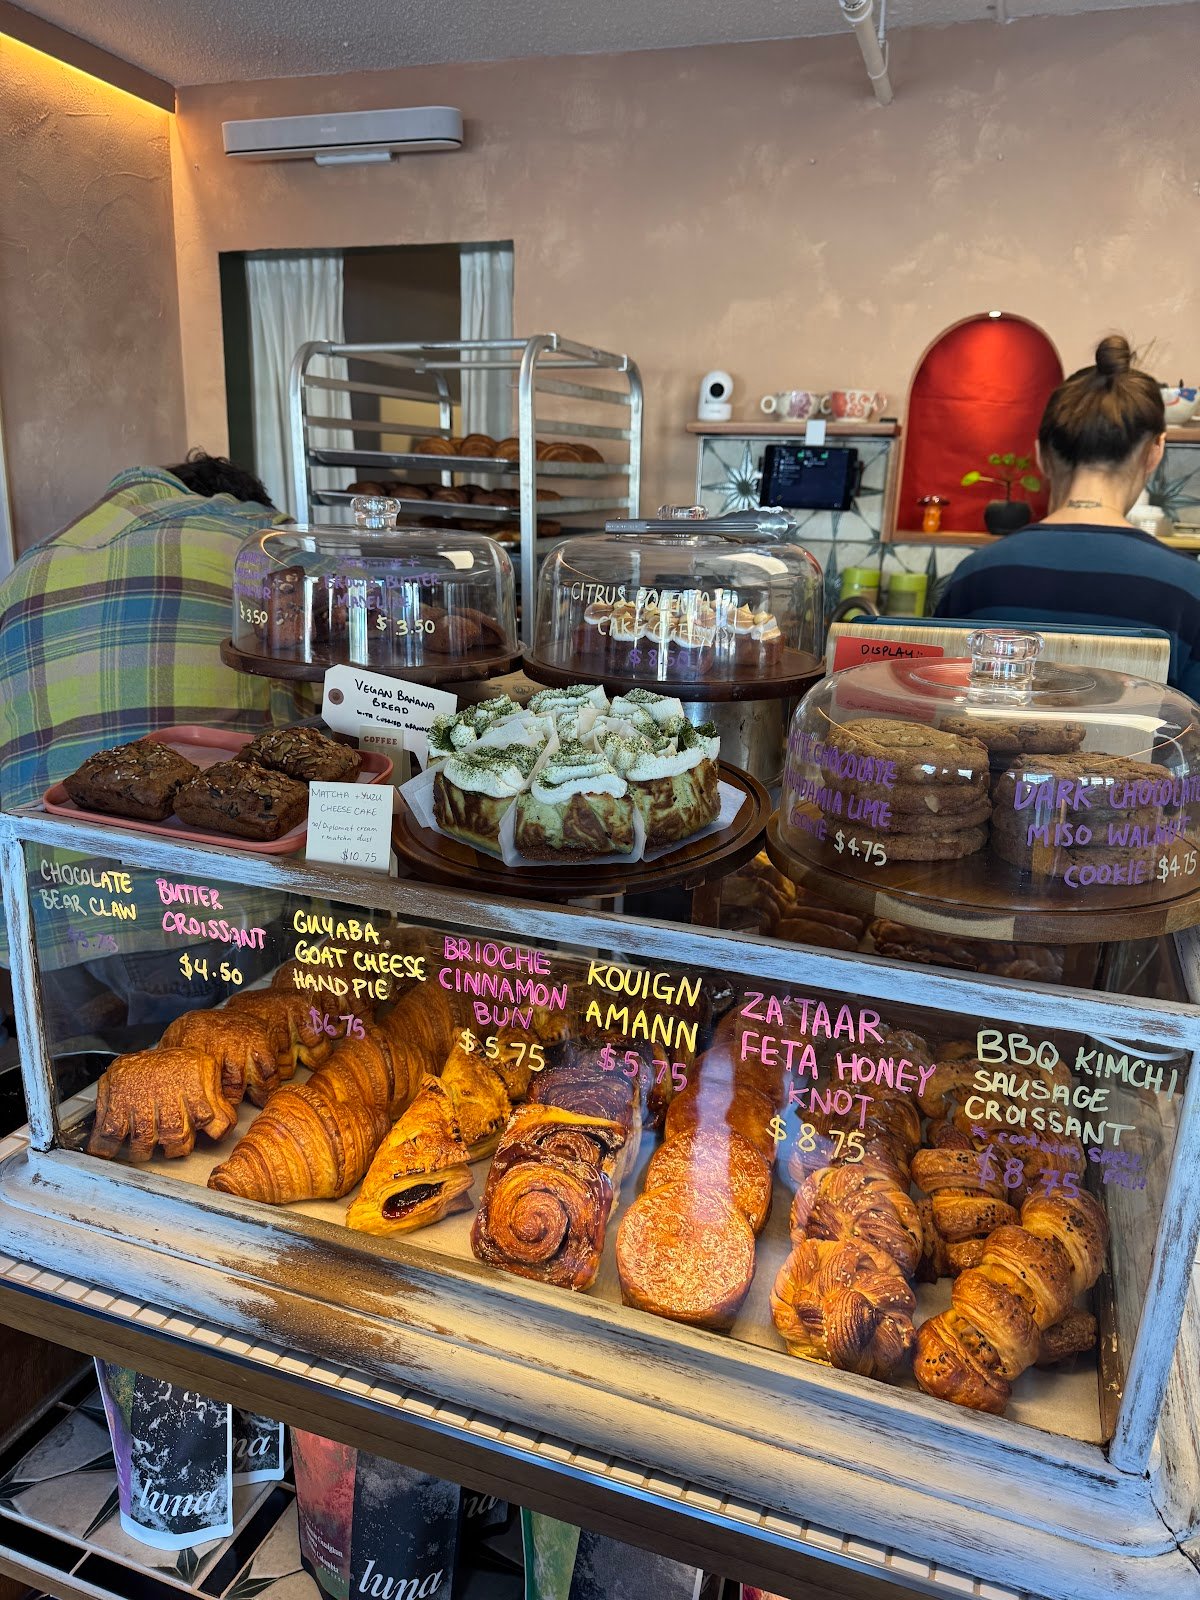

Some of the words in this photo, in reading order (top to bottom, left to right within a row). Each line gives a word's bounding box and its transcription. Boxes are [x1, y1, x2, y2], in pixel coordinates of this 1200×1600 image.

[385, 572, 442, 588] BUTTER
[571, 581, 626, 605] CITRUS
[597, 615, 643, 636] CAKE
[354, 678, 393, 698] VEGAN
[397, 689, 435, 711] BANANA
[372, 697, 409, 715] BREAD
[363, 735, 398, 746] COFFEE
[813, 743, 898, 791] CHOCOLATE
[311, 788, 350, 799] MATCHA
[361, 791, 383, 802] YUZU
[320, 803, 352, 814] CHEESE
[353, 807, 377, 816] CAKE
[847, 795, 893, 828] LIME
[1014, 779, 1095, 811] DARK
[833, 829, 888, 867] $4.75
[1027, 822, 1092, 848] MISO
[1108, 815, 1192, 848] WALNUT
[341, 848, 377, 864] $10.75
[1064, 858, 1147, 888] COOKIE
[1156, 850, 1198, 884] $4.75
[40, 859, 133, 894] CHOCOLATE
[156, 877, 223, 910] BUTTER
[39, 888, 87, 916] BEAR
[89, 896, 137, 921] CLAW
[161, 910, 267, 950] CROISSANT
[293, 909, 380, 945] GUYABA
[179, 952, 243, 985] $4.50
[294, 940, 348, 969] GOAT
[353, 950, 427, 981] CHEESE
[444, 935, 551, 975] BRIOCHE
[292, 967, 349, 997] HAND
[351, 979, 389, 1000] PIE
[438, 967, 568, 1011] CINNAMON
[587, 960, 703, 1007] KOUIGN
[473, 1001, 533, 1030] BUN
[586, 1000, 698, 1053] AMANN
[740, 991, 885, 1045] ZA'TAAR
[740, 1030, 819, 1080] FETA
[836, 1052, 937, 1098] HONEY
[976, 1029, 1060, 1075] BBQ
[1075, 1046, 1178, 1102] KIMCHI
[788, 1081, 875, 1130] KNOT
[972, 1070, 1110, 1113] SAUSAGE
[964, 1095, 1136, 1146] CROISSANT
[137, 1478, 219, 1517] luna
[358, 1558, 444, 1600] luna
